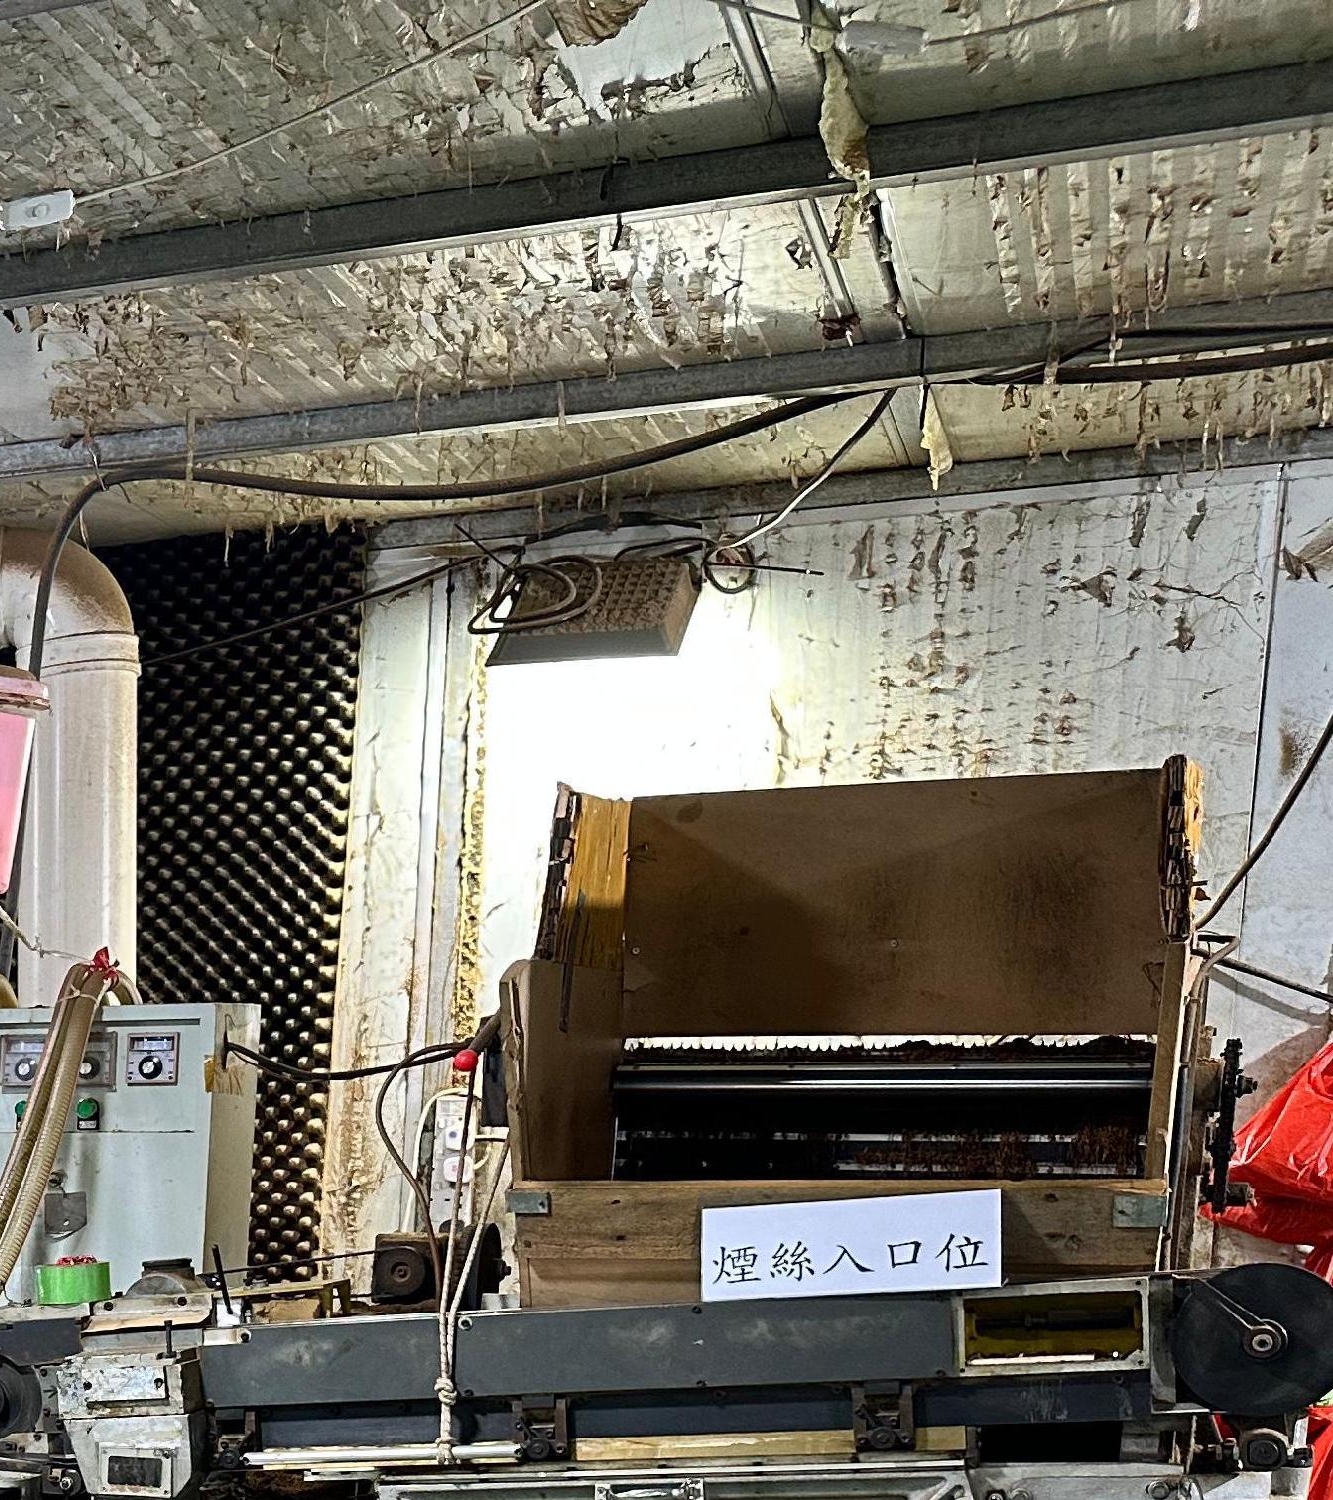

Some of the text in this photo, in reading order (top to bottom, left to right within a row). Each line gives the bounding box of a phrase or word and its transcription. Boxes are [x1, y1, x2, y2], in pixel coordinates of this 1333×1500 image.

[711, 1232, 989, 1285] 煙絲入口位
